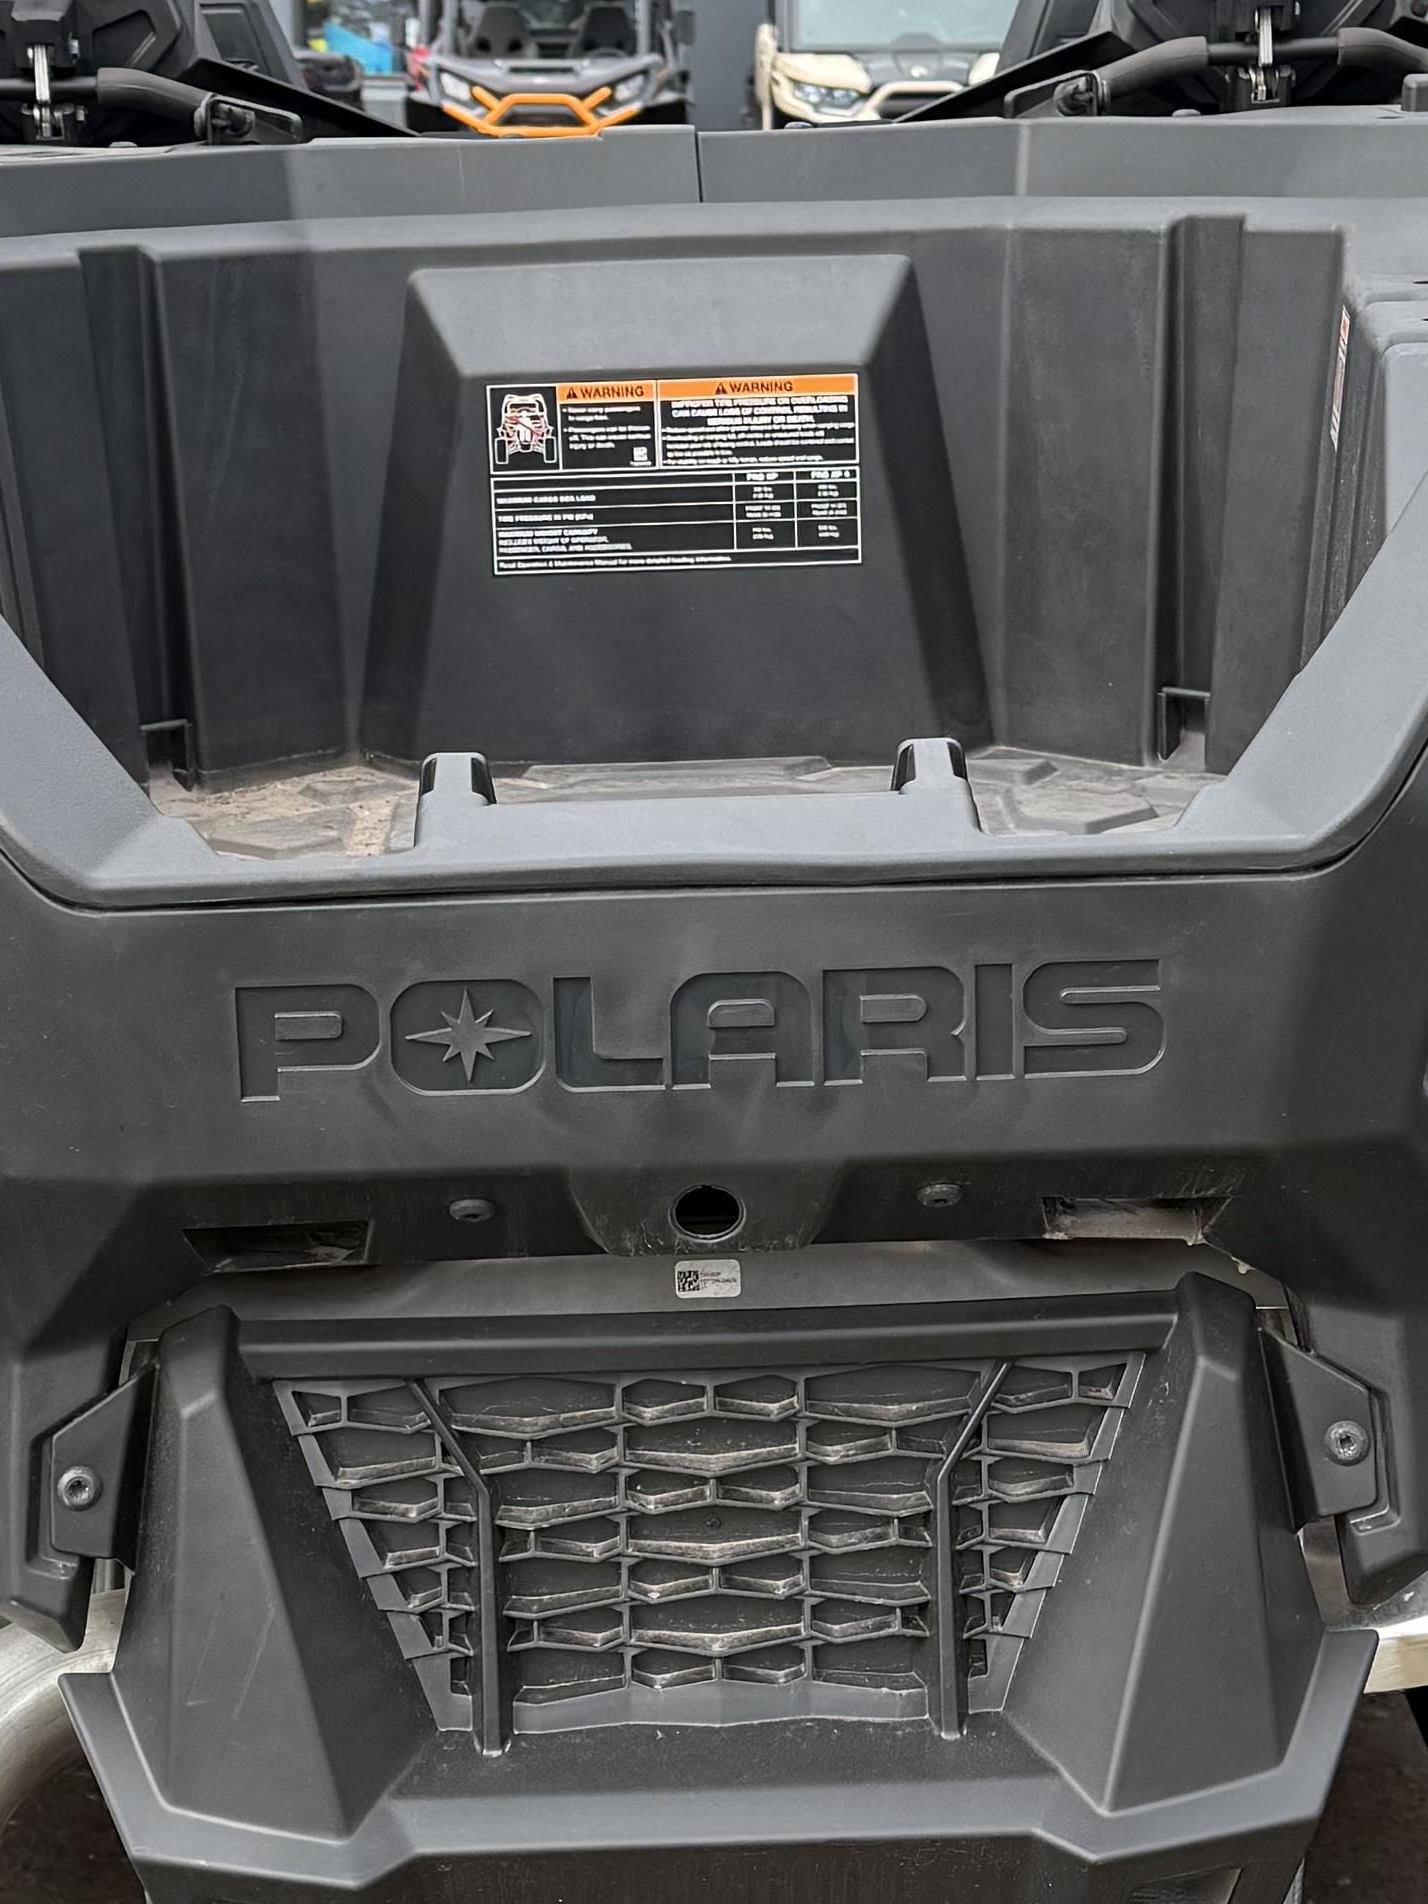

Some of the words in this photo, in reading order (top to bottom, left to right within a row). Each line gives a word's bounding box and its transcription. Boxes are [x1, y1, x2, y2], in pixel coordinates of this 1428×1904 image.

[580, 385, 645, 398] WARNING
[730, 381, 793, 394] WARNING
[235, 959, 1168, 1103] POLARIS
